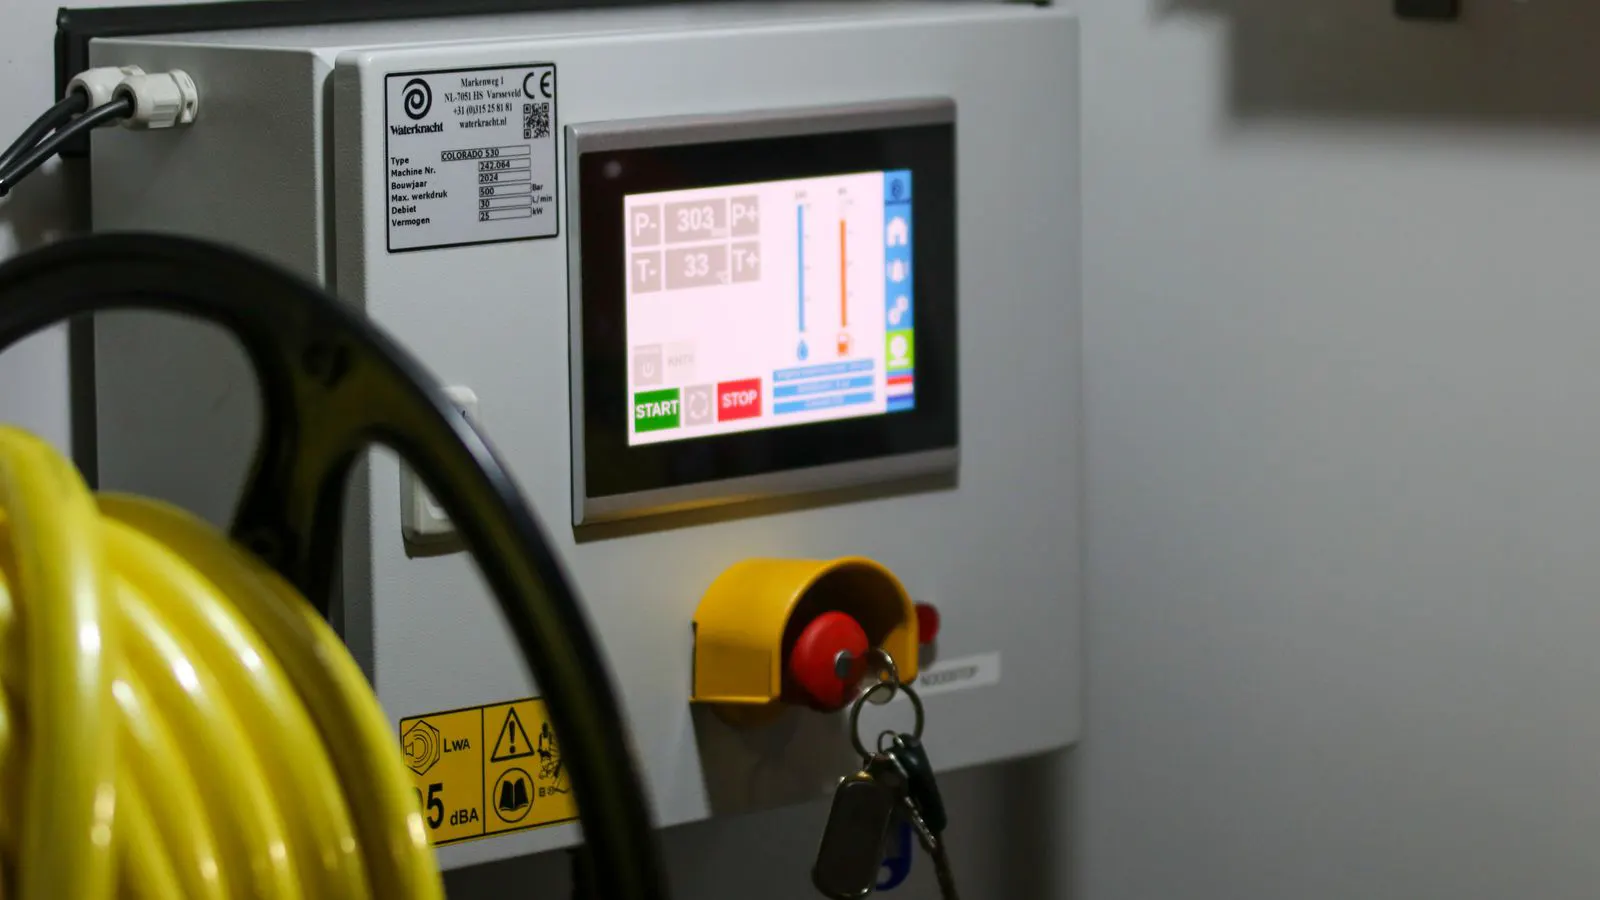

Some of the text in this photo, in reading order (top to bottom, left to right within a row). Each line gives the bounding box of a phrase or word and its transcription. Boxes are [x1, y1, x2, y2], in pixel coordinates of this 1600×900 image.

[460, 77, 500, 88] Markenweg
[444, 89, 521, 103] NL-7051 HS Varsseveld
[453, 102, 513, 116] +31 (0)315 25 81 81
[390, 122, 444, 136] Waterkracht
[459, 117, 507, 129] waterkracht.nl
[391, 157, 410, 165] Type
[441, 150, 483, 161] COLORADO
[391, 160, 511, 177] Machine Nr. 242.064
[391, 173, 499, 190] Bouwjaar 2024
[391, 183, 543, 202] Max. werkdruk 500 Bar
[391, 195, 553, 214] Debiet 30 L/min
[391, 207, 543, 227] Vermogen 25 kW
[677, 206, 715, 233] 303
[732, 203, 758, 228] P+
[684, 253, 710, 278] 33
[732, 248, 759, 273] T+
[635, 398, 679, 419] START
[721, 390, 758, 409] STOP
[450, 807, 479, 826] dBA
